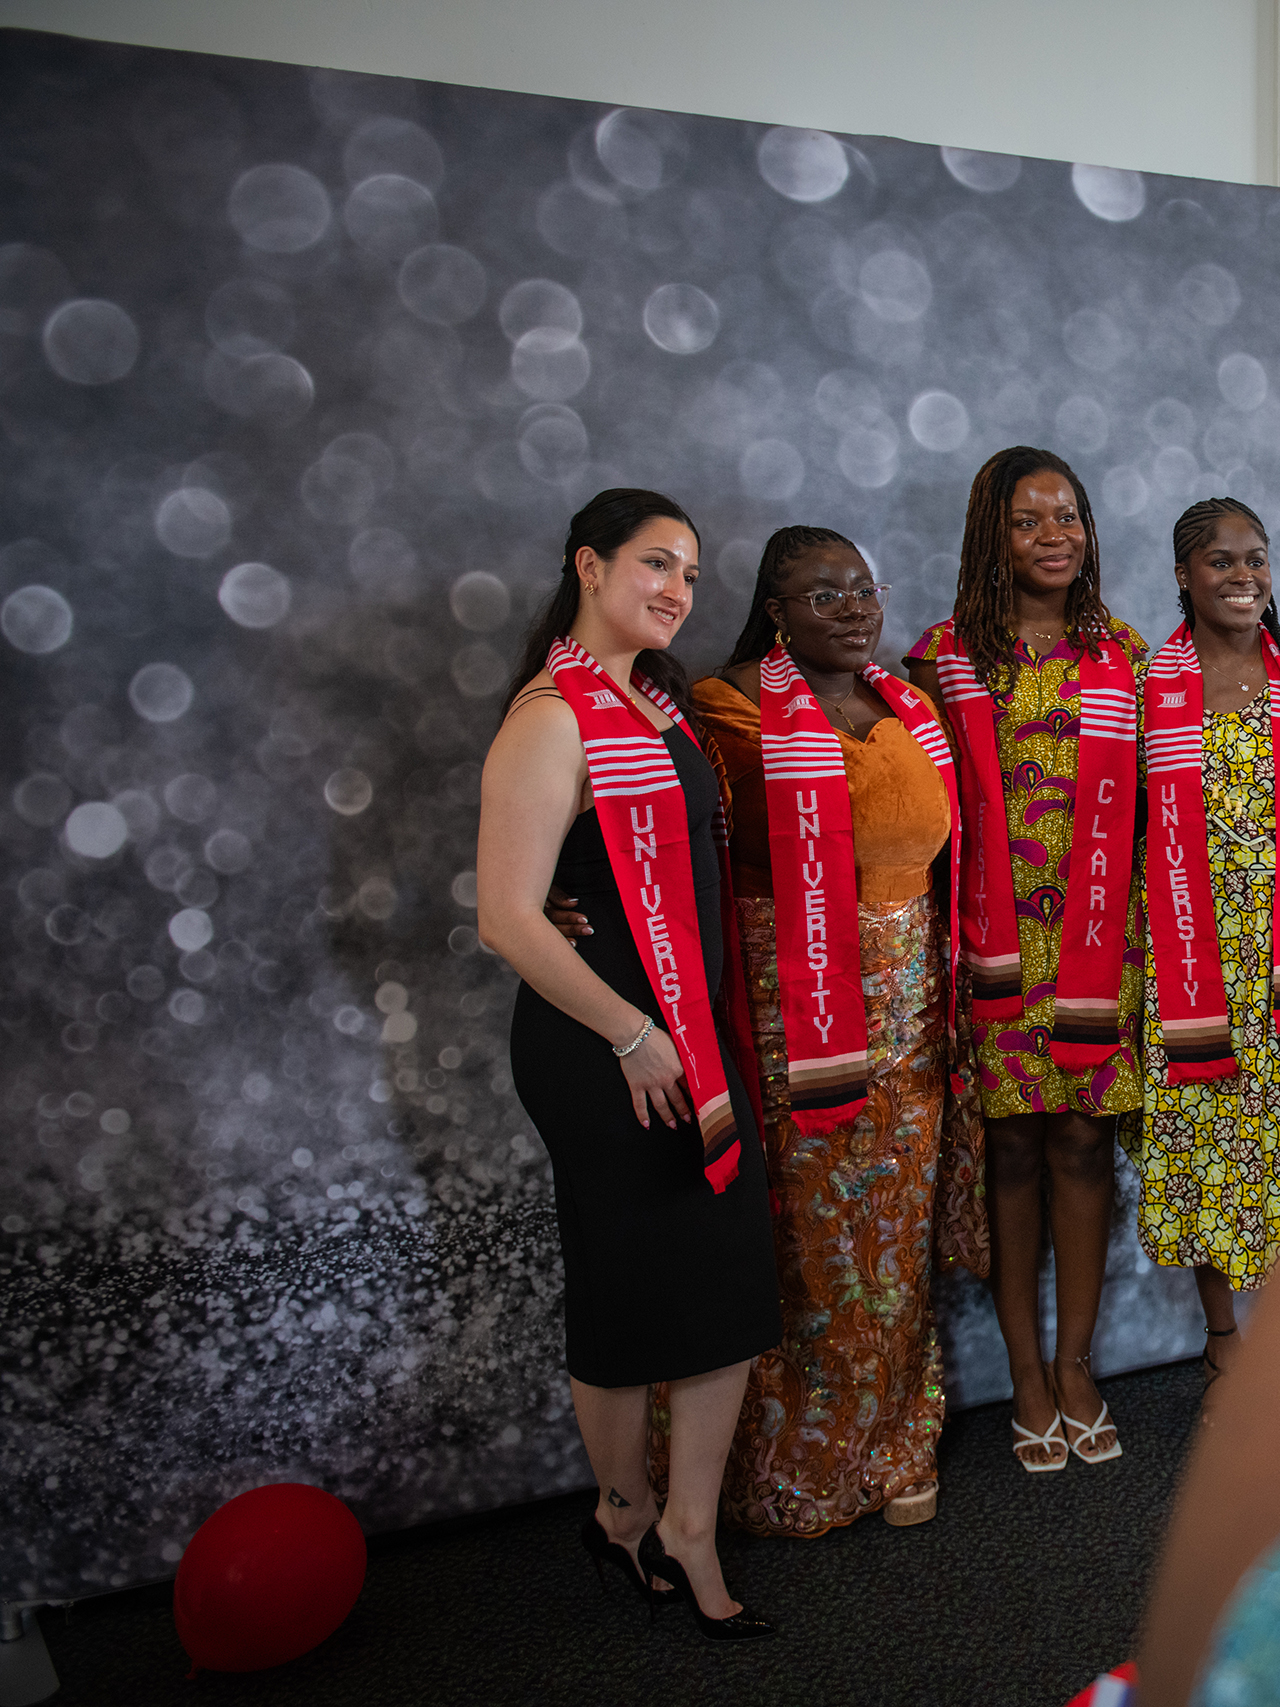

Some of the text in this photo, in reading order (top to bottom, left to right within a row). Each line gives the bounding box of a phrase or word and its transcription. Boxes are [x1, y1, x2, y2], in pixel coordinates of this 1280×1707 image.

[796, 789, 833, 1044] UNIVERSITY
[1085, 778, 1115, 947] CLARK
[1160, 783, 1198, 1007] UNIVERSITY
